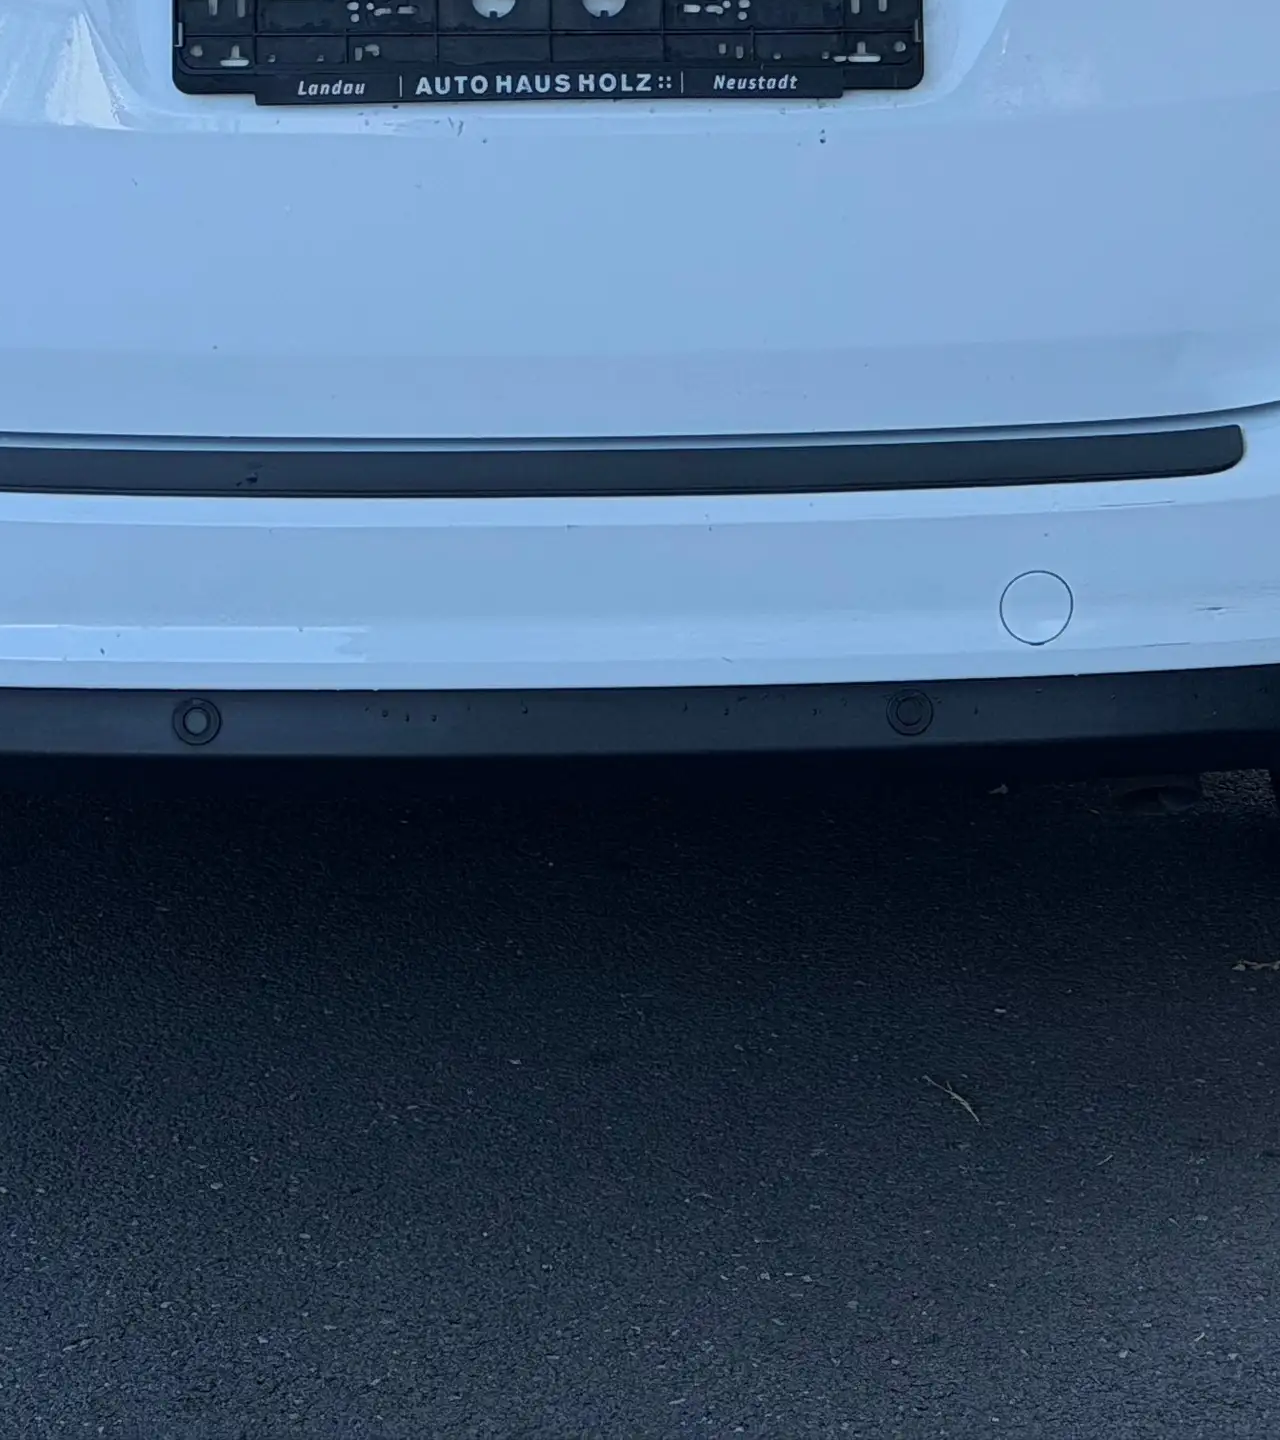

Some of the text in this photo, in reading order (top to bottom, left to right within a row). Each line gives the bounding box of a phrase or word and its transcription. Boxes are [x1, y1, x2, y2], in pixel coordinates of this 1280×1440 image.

[297, 73, 798, 95] Landau AUTO HAUS HOLZ Neustadt
